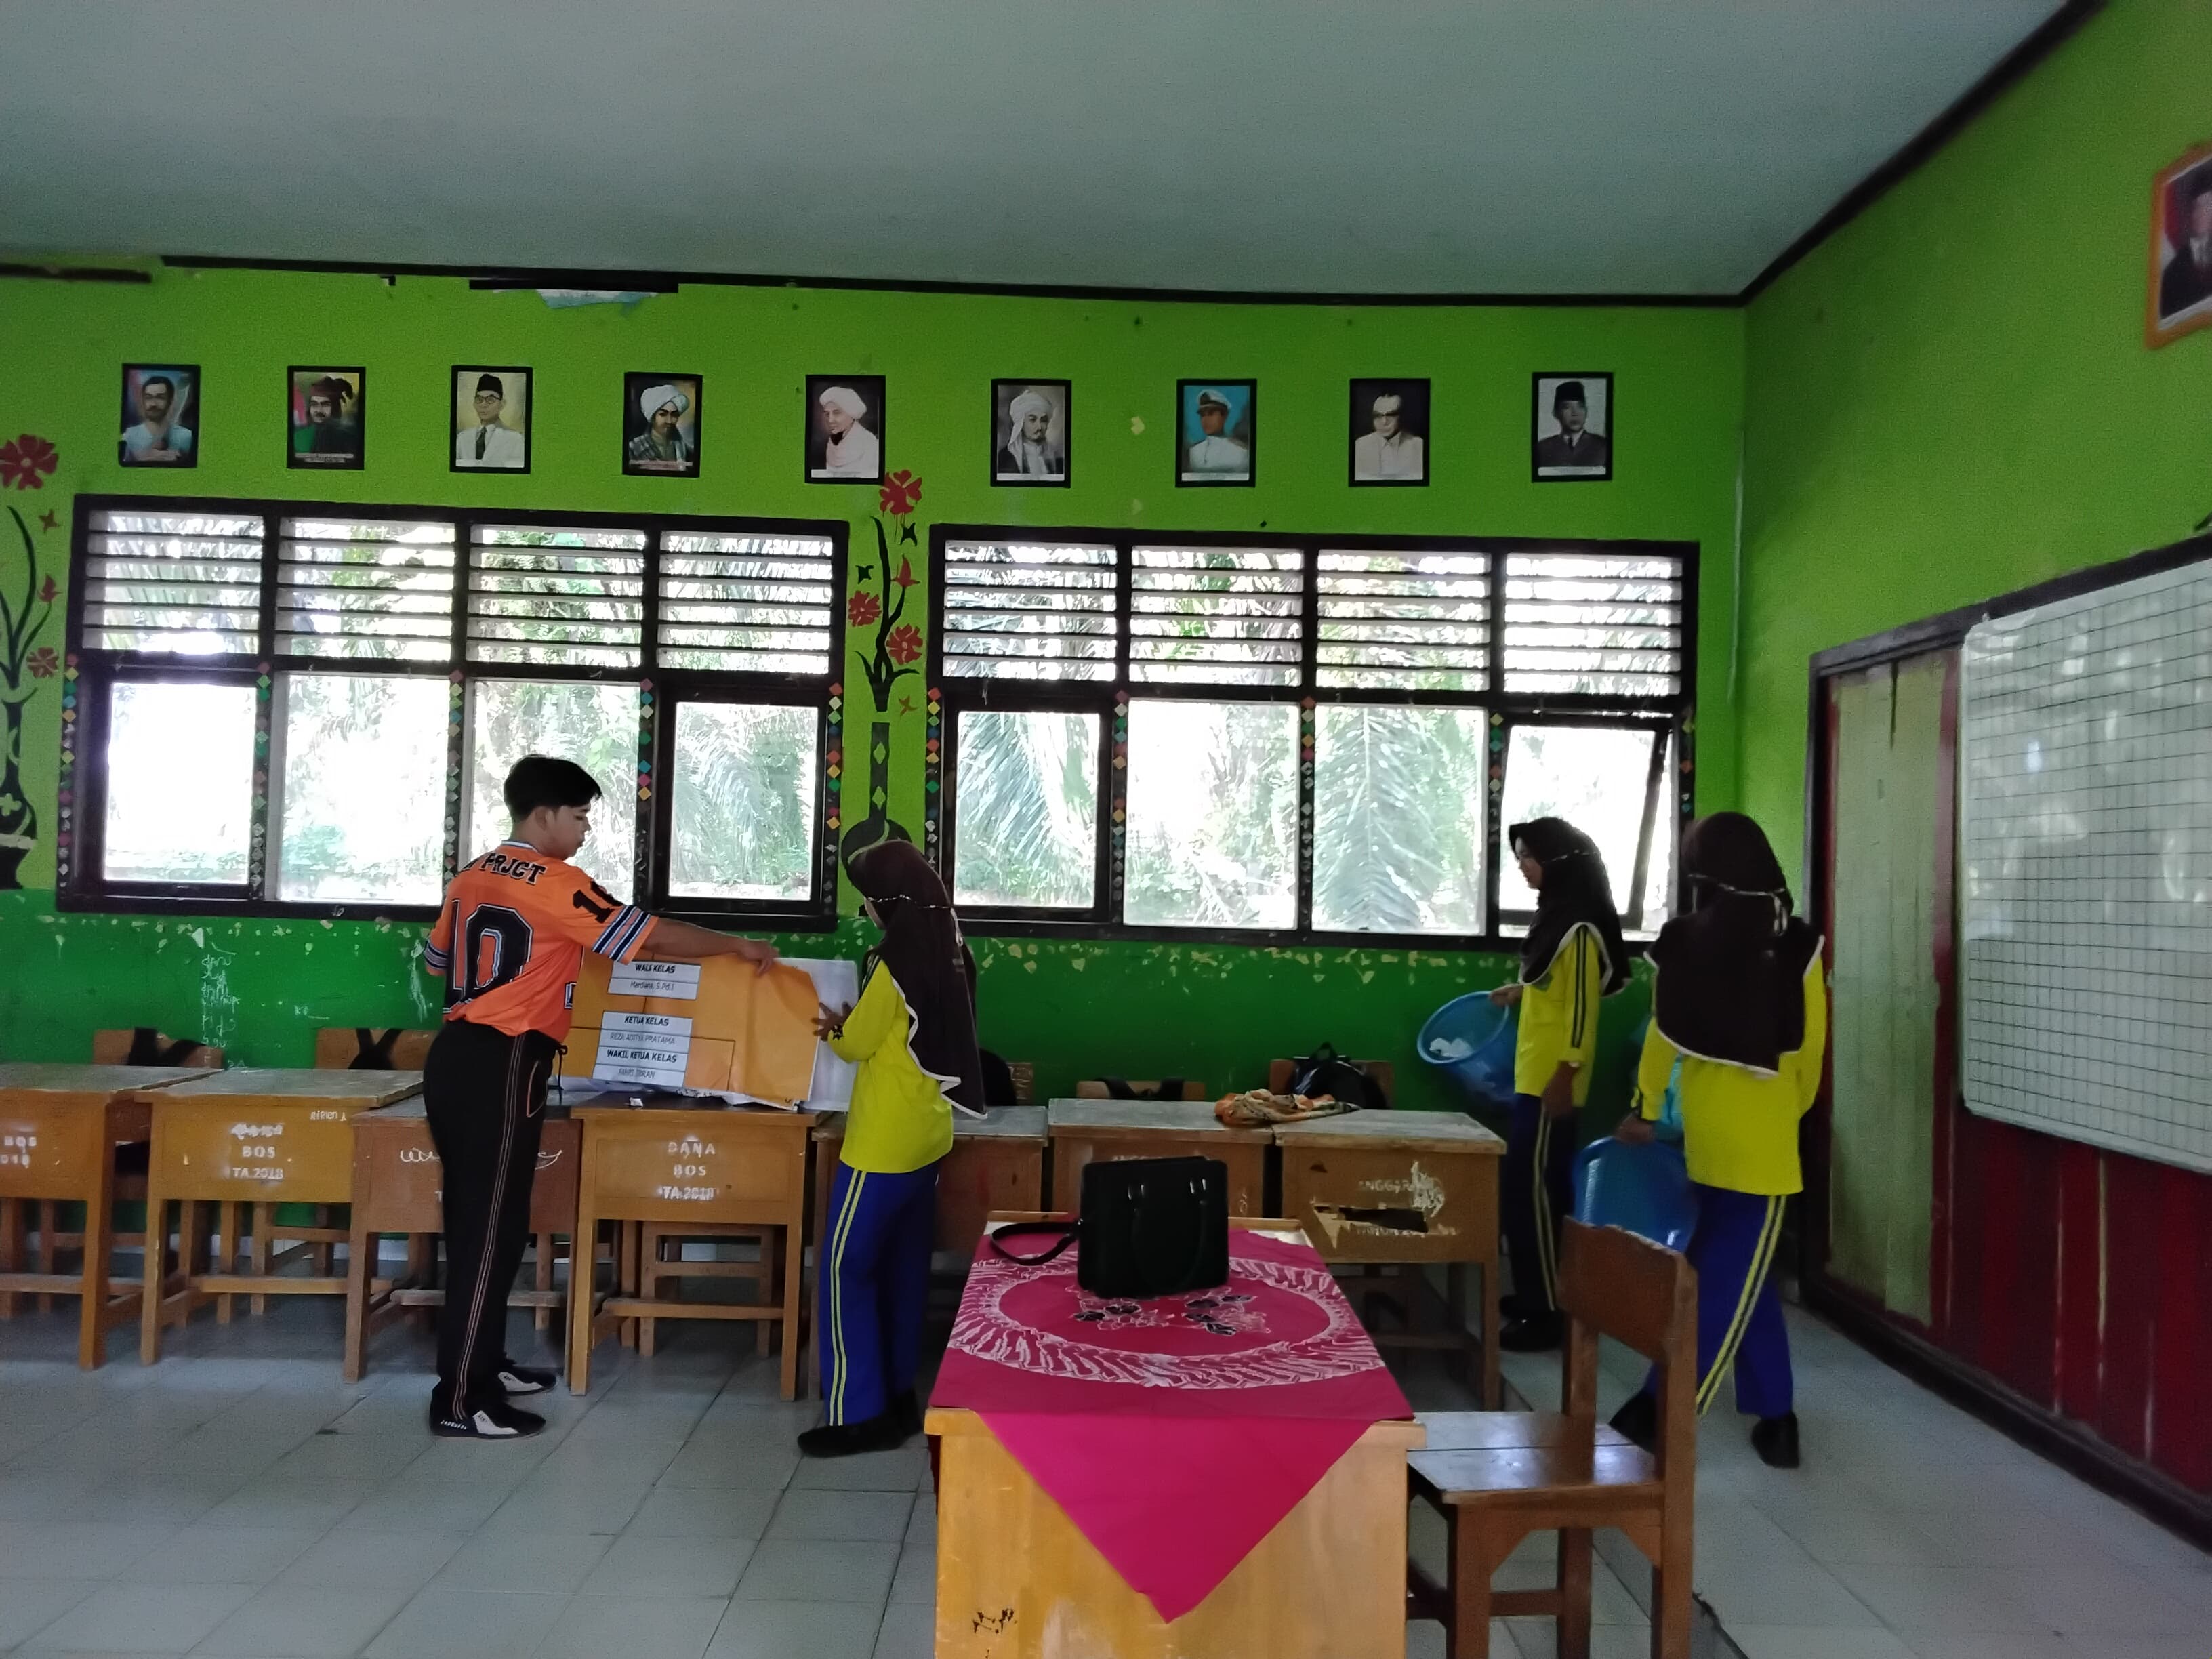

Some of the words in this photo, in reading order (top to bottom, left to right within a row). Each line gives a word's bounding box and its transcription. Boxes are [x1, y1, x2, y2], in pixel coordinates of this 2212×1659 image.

[635, 964, 651, 972] WALI
[653, 965, 676, 974] KELAS
[624, 1015, 644, 1025] KETUA
[645, 1017, 670, 1027] KELAS
[644, 1035, 676, 1045] PRATAMA
[607, 1049, 629, 1059] WAKIL
[630, 1050, 650, 1061] KETUA
[651, 1052, 678, 1063] KELAS
[242, 1146, 276, 1158] BOS
[673, 1164, 707, 1178] BOS
